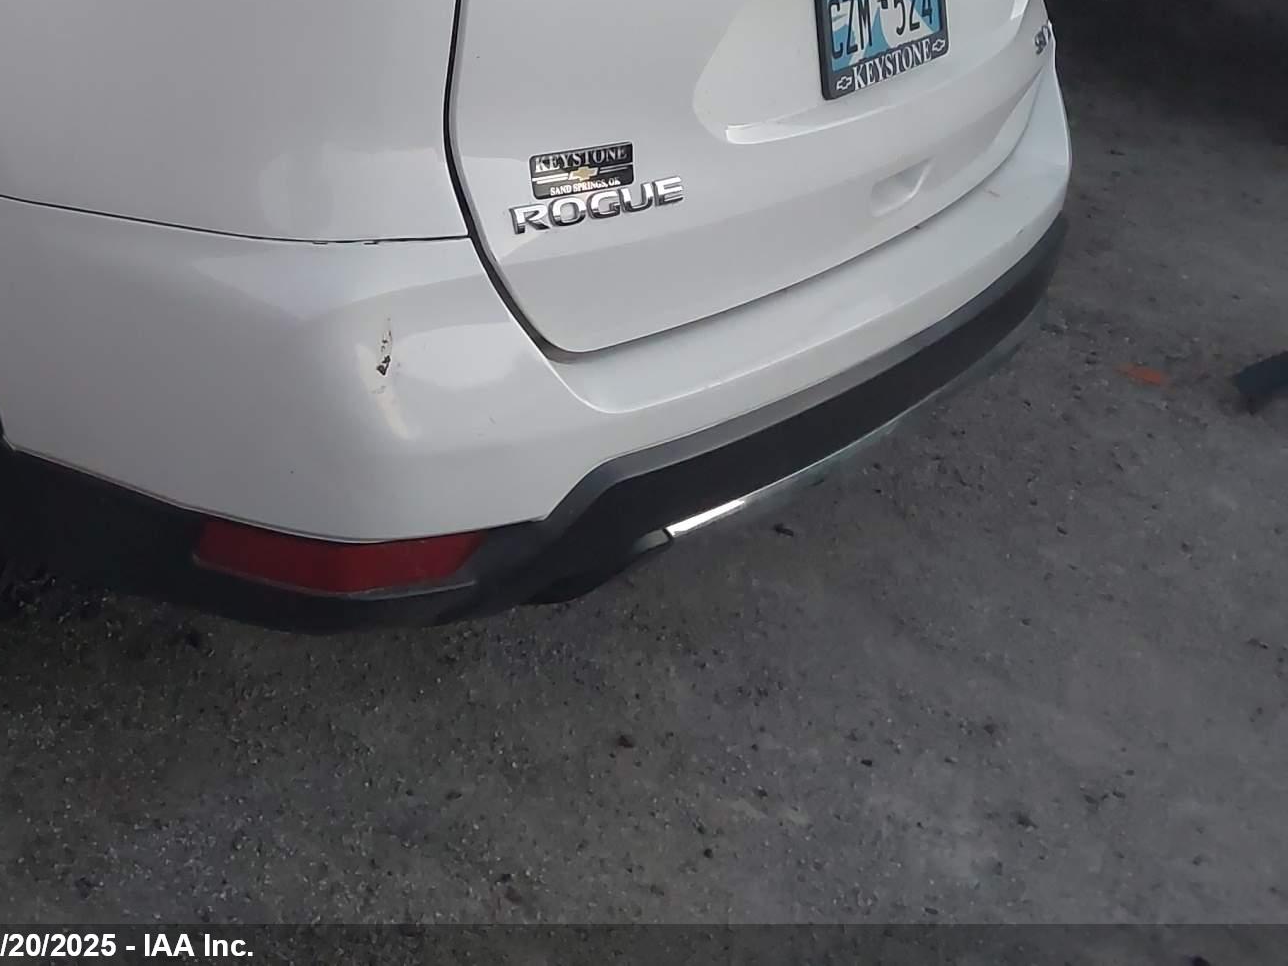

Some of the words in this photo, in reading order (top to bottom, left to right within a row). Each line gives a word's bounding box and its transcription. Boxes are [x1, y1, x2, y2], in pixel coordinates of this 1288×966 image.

[853, 38, 932, 91] KEYSTONE
[534, 146, 627, 173] KEYSTONE
[509, 175, 684, 235] ROGUE
[550, 185, 572, 197] SAND
[609, 176, 621, 187] OK
